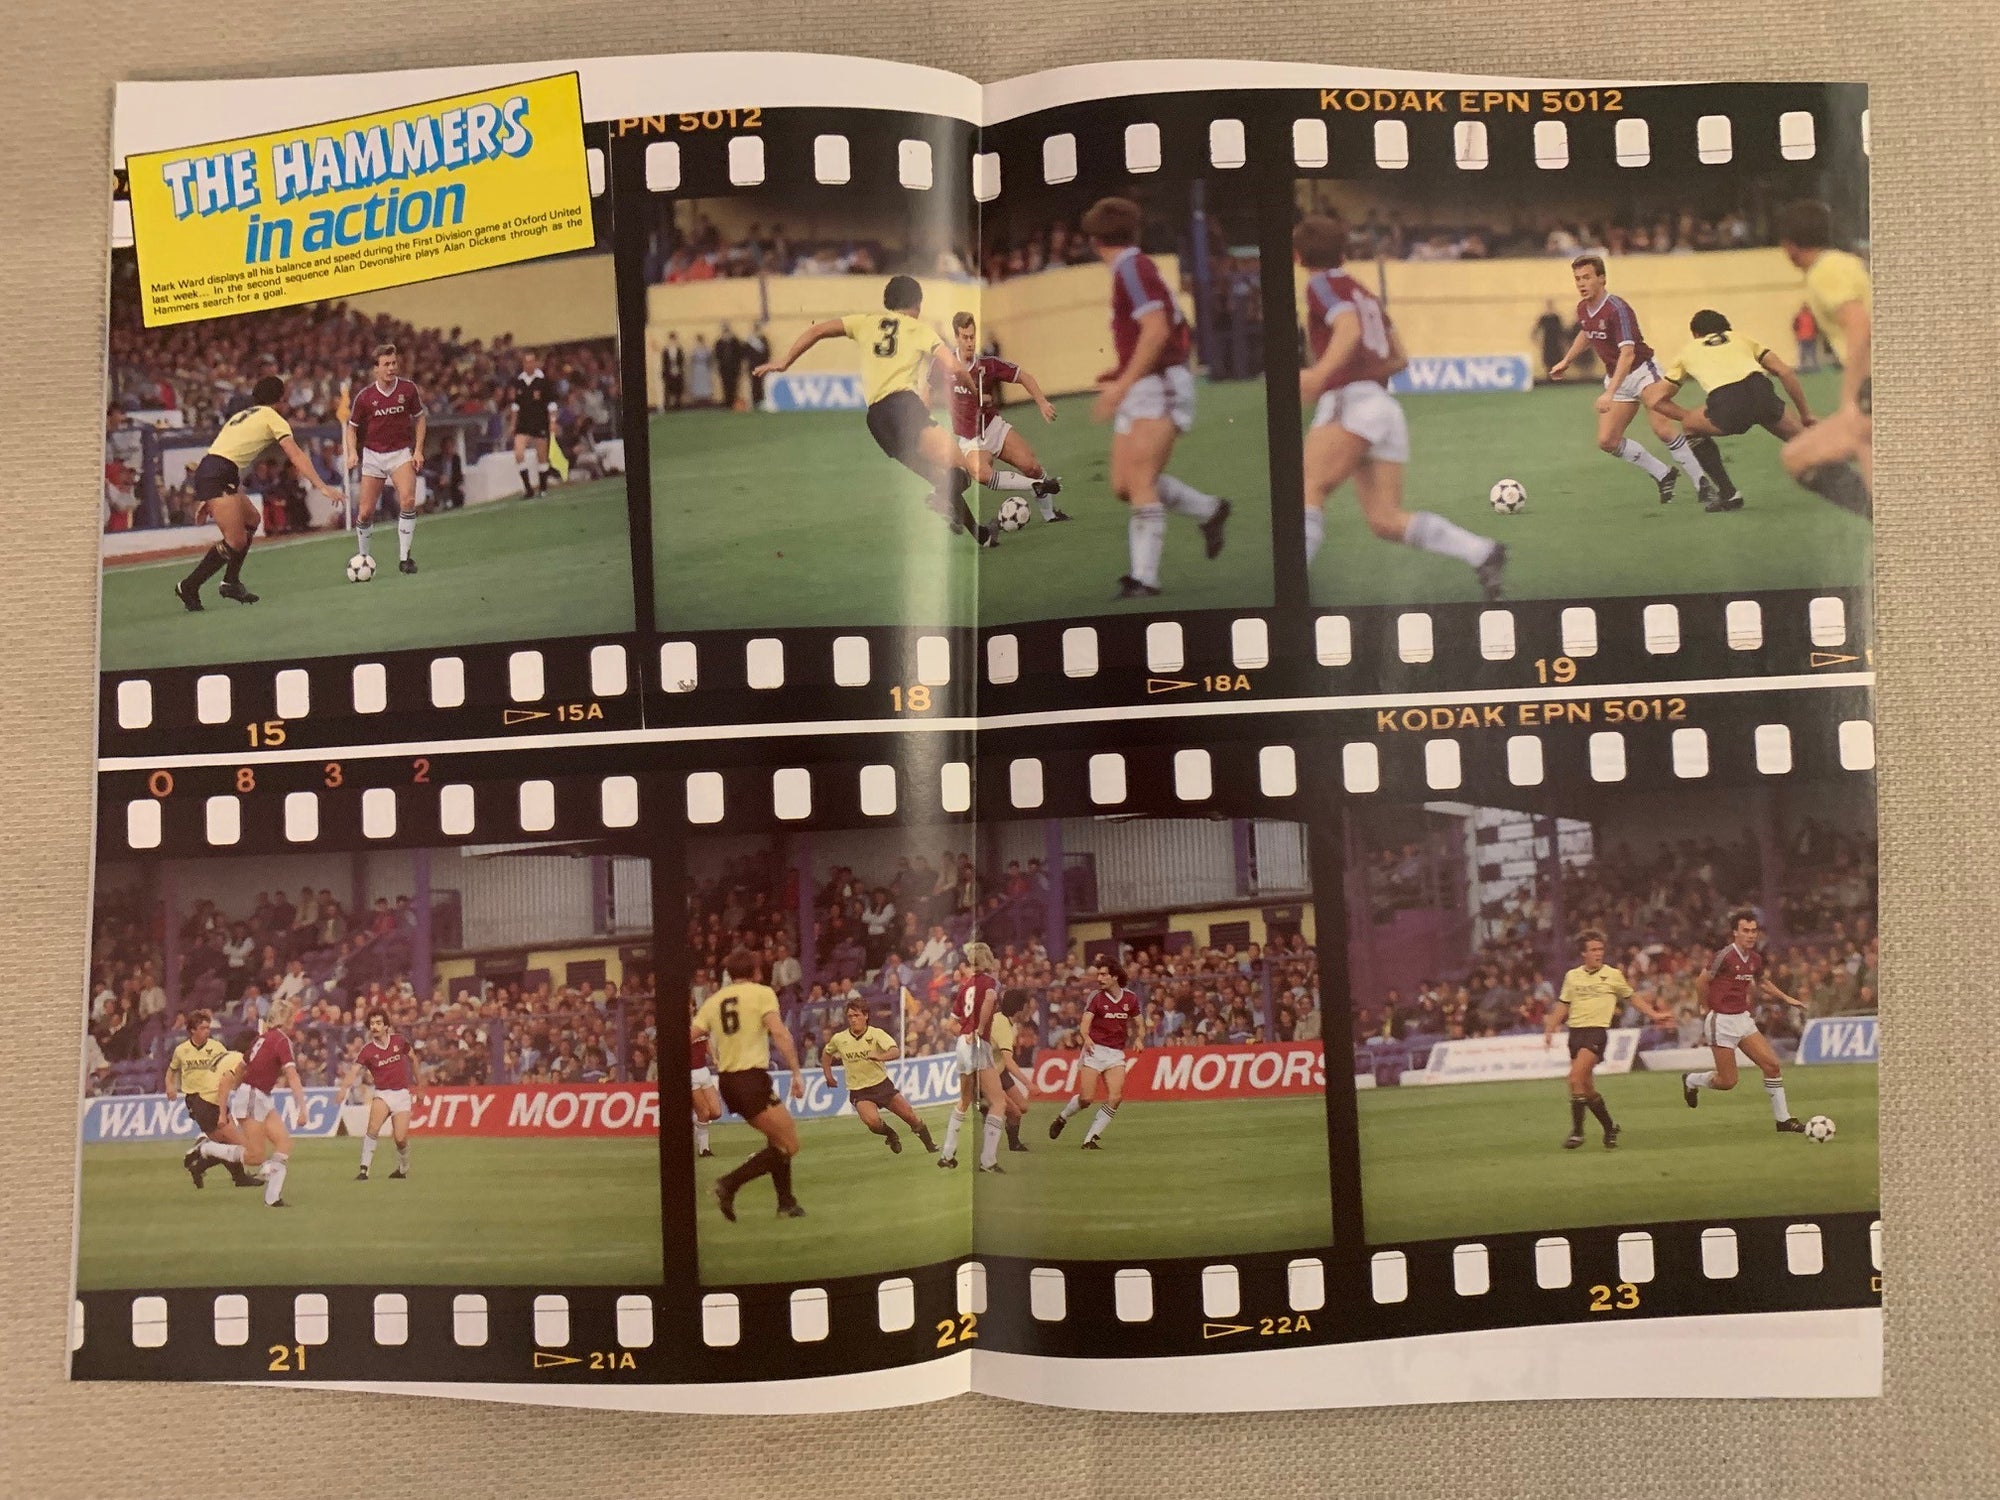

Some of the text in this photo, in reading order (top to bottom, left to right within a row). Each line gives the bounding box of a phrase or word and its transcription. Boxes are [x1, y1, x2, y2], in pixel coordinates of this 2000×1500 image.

[1319, 88, 1624, 113] KODAK EPN 5012
[610, 107, 763, 137] PN 5012
[162, 96, 533, 220] THE HAMMERS
[245, 182, 466, 264] in action
[151, 205, 582, 293] Mark Ward displays all his balance and speed during the First Division game at Oxford United
[152, 218, 583, 305] last week... In the second sequence Alan Devonshire plays Alan Dickens through as the
[153, 286, 287, 316] Hammers search for a goal.
[873, 317, 899, 358] 3
[1409, 358, 1515, 389] WANG
[374, 405, 405, 417] AVCO
[1203, 673, 1252, 693] 18A
[1534, 656, 1577, 684] 19
[557, 702, 604, 722] 15A
[889, 684, 932, 712] 18
[1377, 697, 1687, 732] KODAK EPN 5012
[246, 720, 287, 747] 15
[236, 767, 256, 793] 8
[324, 762, 343, 788] 3
[412, 758, 430, 783] 2
[720, 996, 740, 1036] 6
[964, 985, 976, 1018] 8
[378, 1054, 401, 1067] AVCO
[1589, 1283, 1641, 1311] 23
[935, 1311, 979, 1349] 22
[1259, 1315, 1312, 1336] 22A
[268, 1344, 307, 1371] 21
[589, 1351, 637, 1371] 21A
